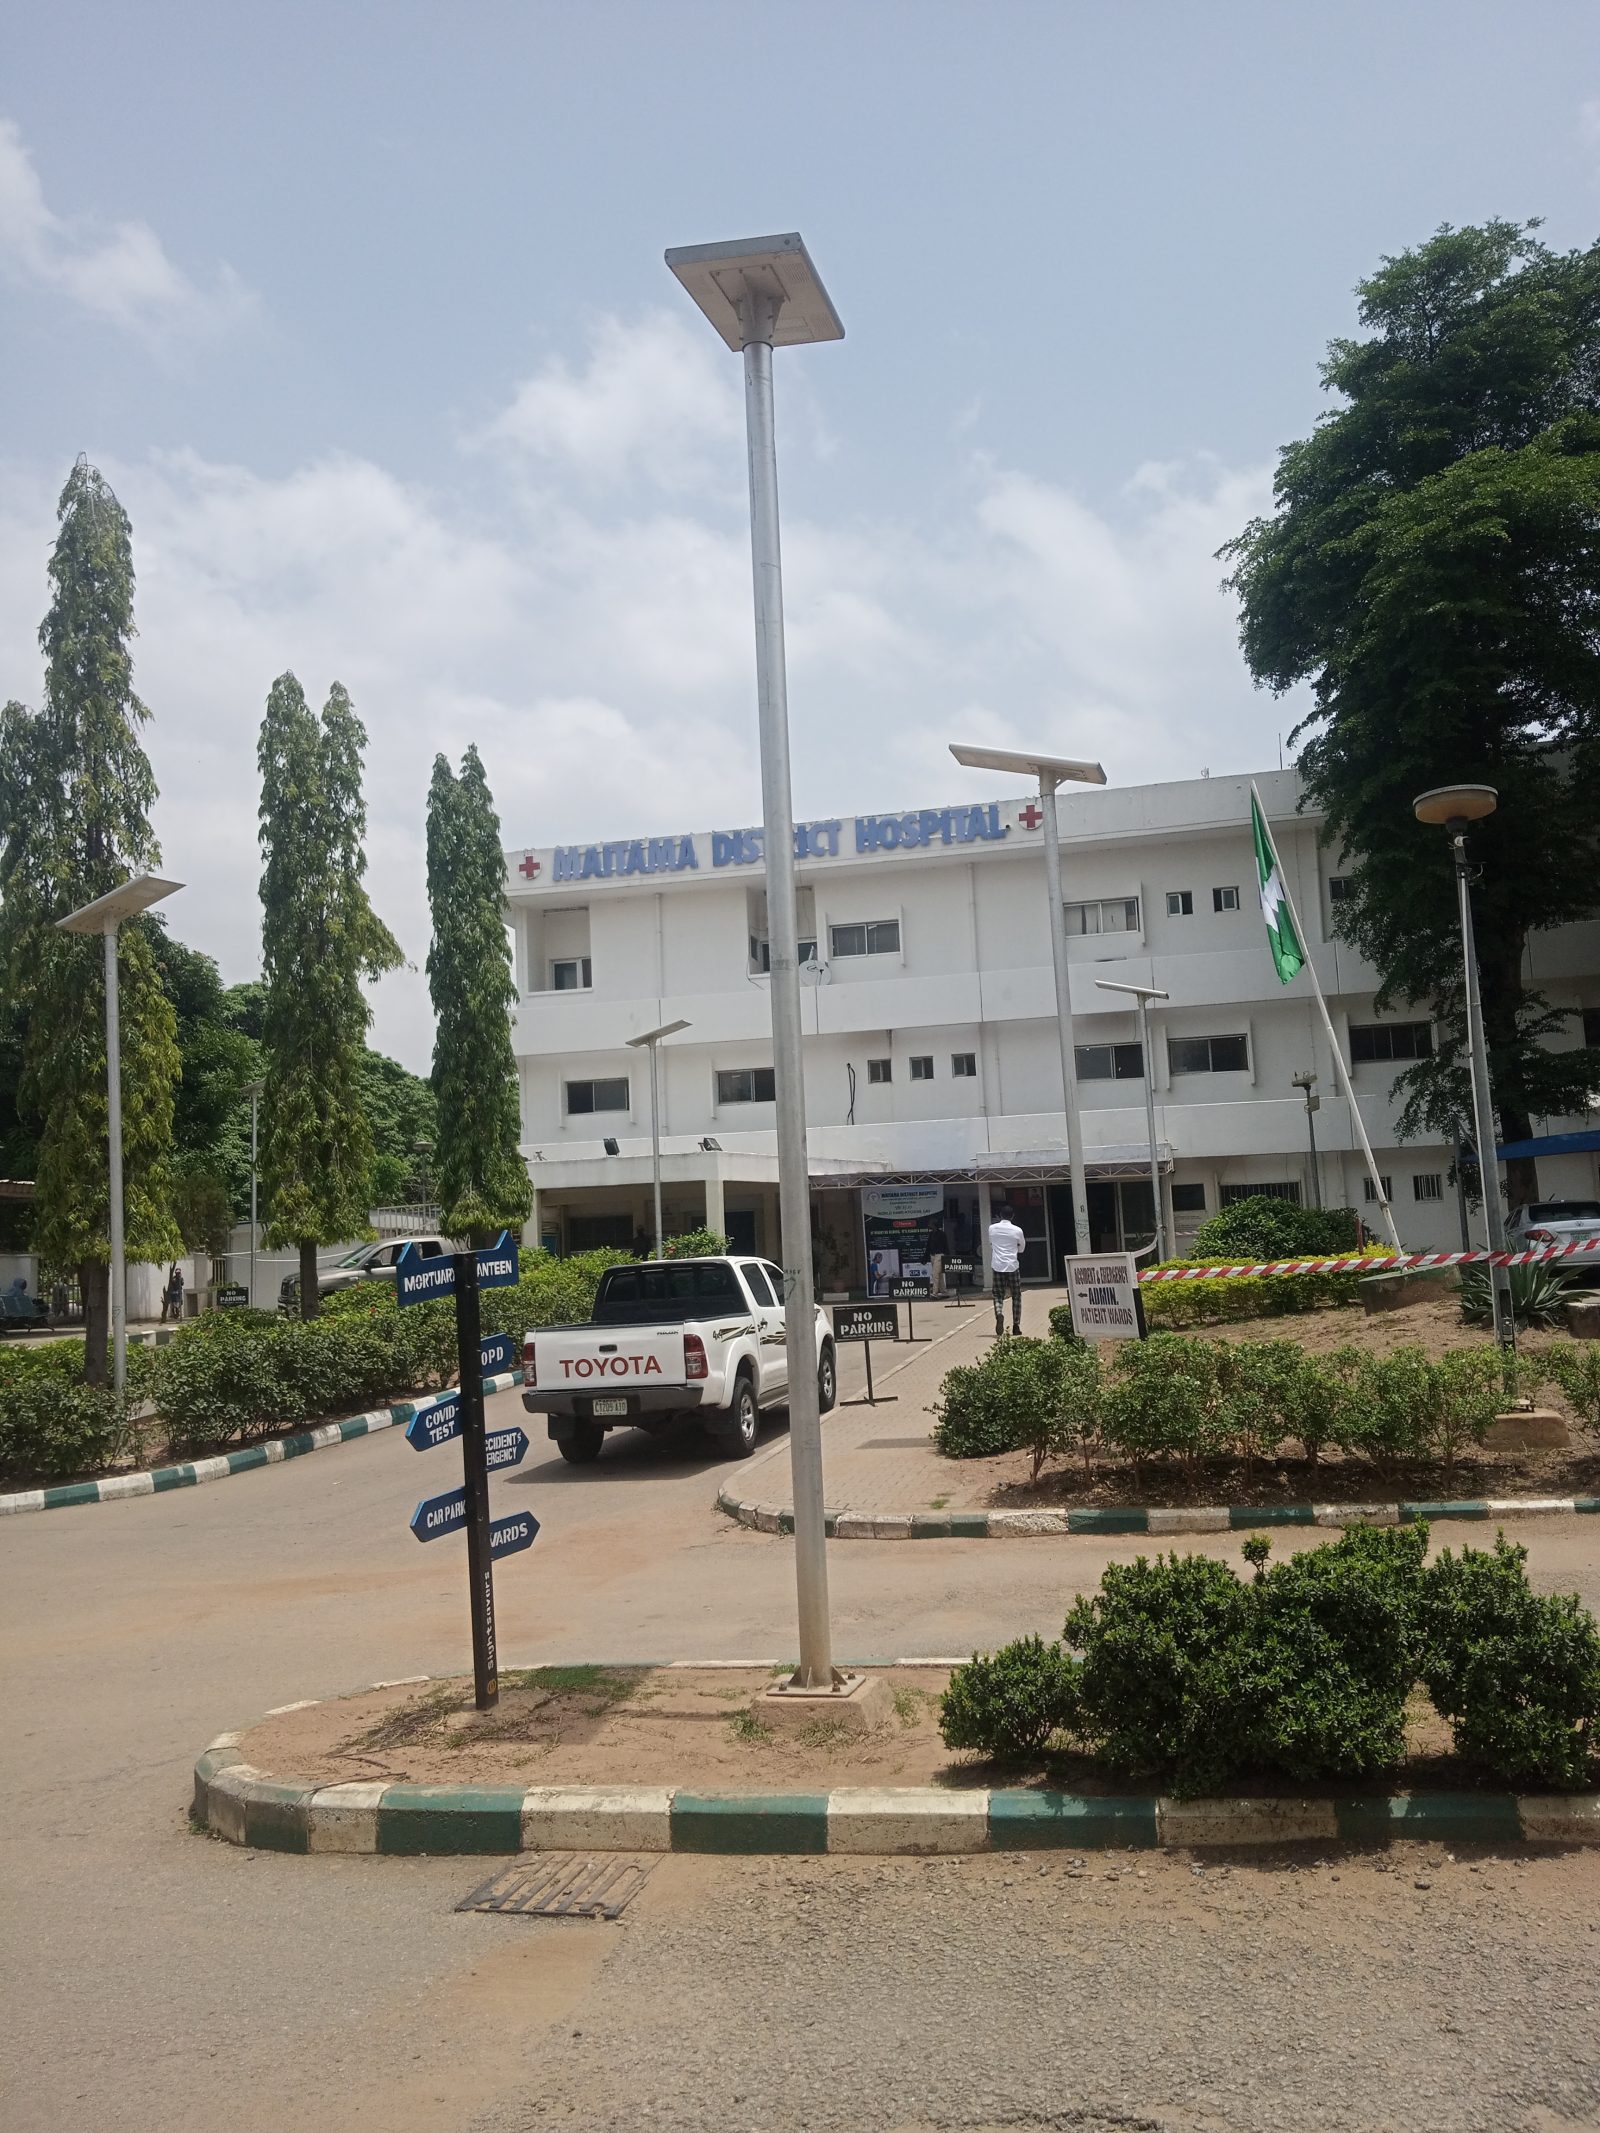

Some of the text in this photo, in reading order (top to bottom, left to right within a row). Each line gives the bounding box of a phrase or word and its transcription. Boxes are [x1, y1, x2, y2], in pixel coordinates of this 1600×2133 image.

[553, 804, 1006, 881] MAITAMA DISICT HOSPITAL
[476, 1260, 512, 1277] ANTEEN
[893, 1287, 928, 1296] PARKING
[901, 1280, 914, 1288] NO
[853, 1311, 872, 1322] NO
[1080, 1307, 1133, 1325] PATIENT WARDS
[840, 1321, 894, 1335] PARKING
[481, 1346, 504, 1366] OPD
[559, 1355, 662, 1378] TOYOTA
[425, 1405, 459, 1428] COVID-
[429, 1420, 455, 1443] TEST
[486, 1446, 517, 1466] ERGENCY
[427, 1499, 466, 1528] CAR PARK
